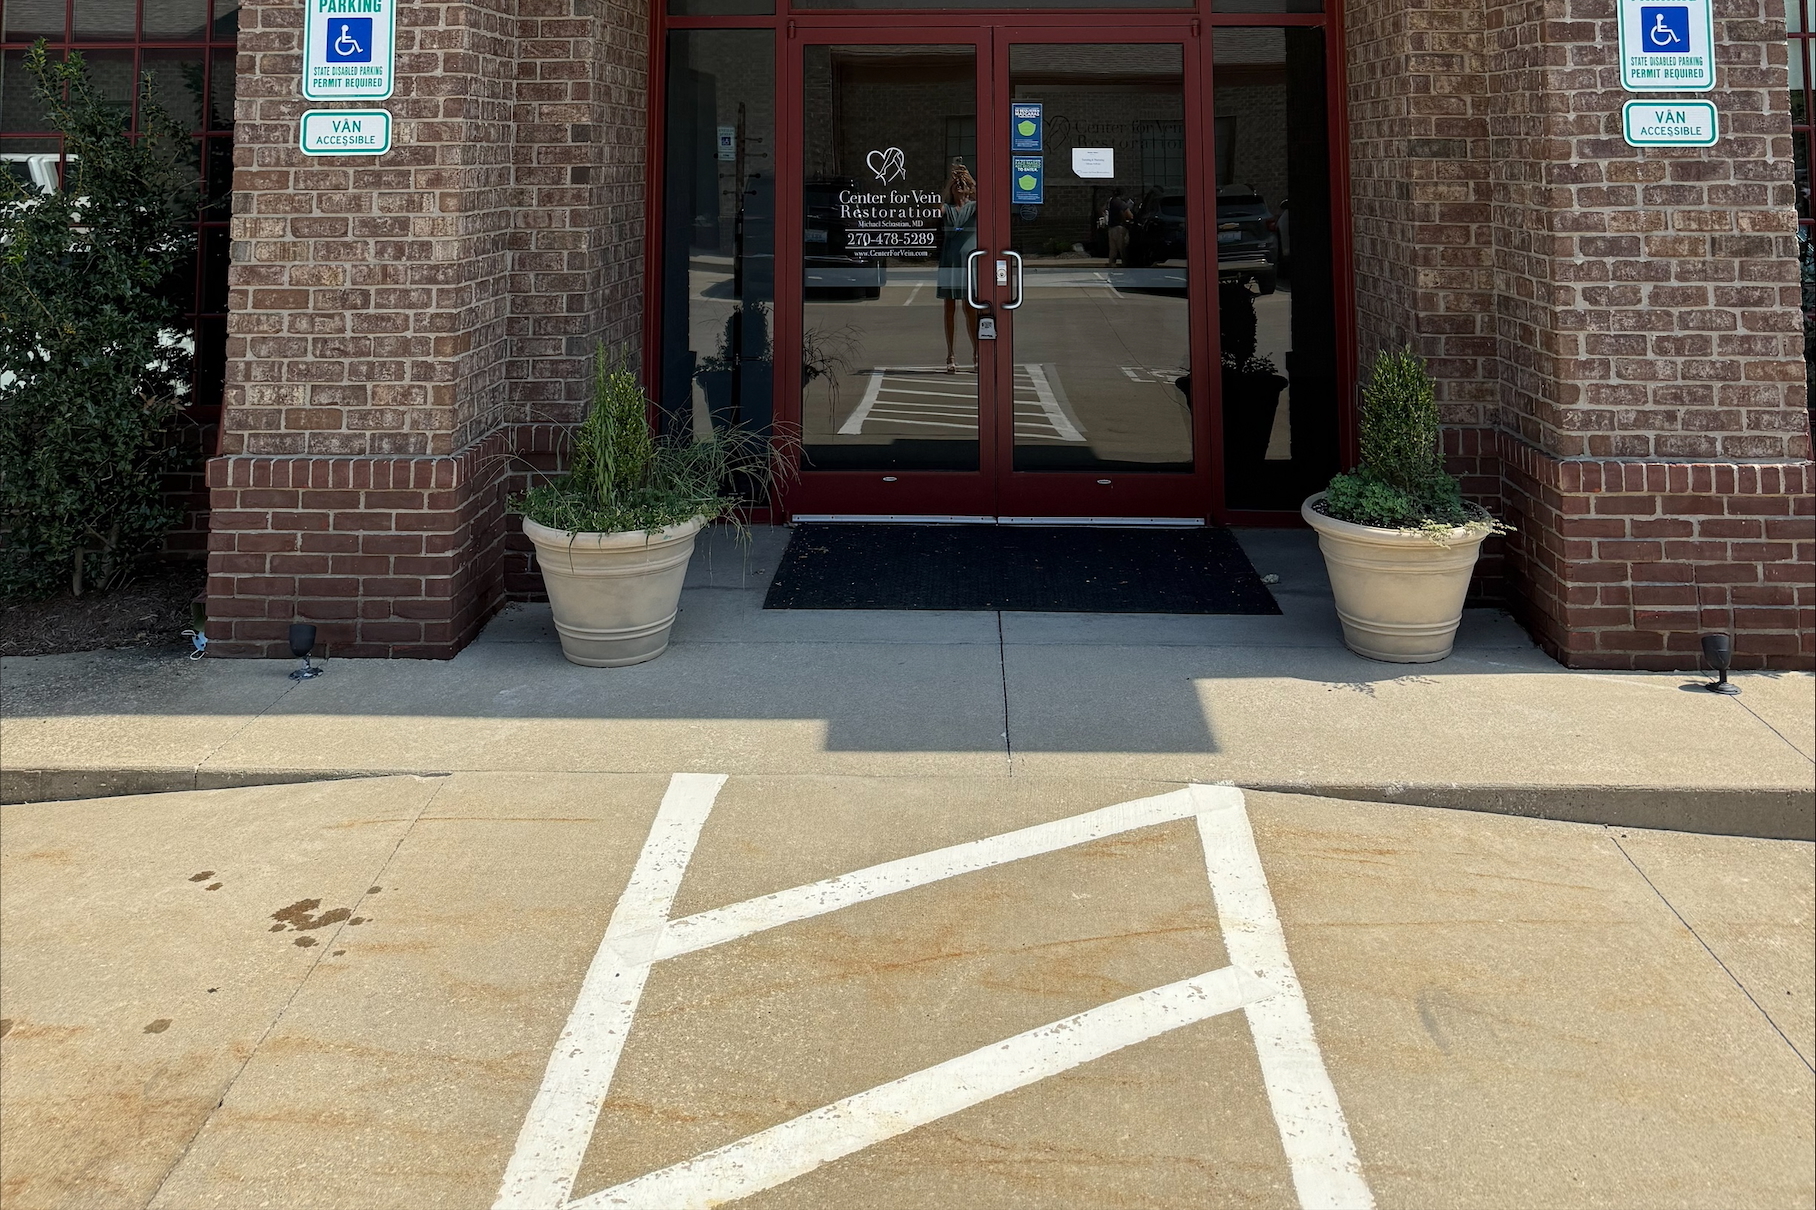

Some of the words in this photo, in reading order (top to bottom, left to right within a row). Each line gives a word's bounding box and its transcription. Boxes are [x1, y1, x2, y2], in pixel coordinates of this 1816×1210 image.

[1630, 56, 1648, 66] STATE
[1649, 56, 1676, 66] DISABLED
[1678, 56, 1703, 66] PARKING
[313, 66, 330, 76] STATE
[332, 66, 358, 76] DISABLED
[359, 66, 383, 75] PARKING
[1631, 69, 1660, 79] PERMIT
[1664, 69, 1704, 80] REQUIRED
[313, 78, 341, 88] PERMIT
[345, 78, 383, 89] REQUIRED
[1655, 111, 1686, 124] VAN
[332, 120, 362, 133] VAN
[1640, 126, 1702, 136] ACCESSIBLE
[315, 135, 376, 145] ACCESSIBLE
[839, 190, 887, 204] Center
[890, 190, 910, 204] for
[911, 190, 942, 204] Vein
[840, 204, 943, 218] Restoration
[858, 220, 881, 228] Michael
[881, 220, 911, 228] Sebastian,
[847, 232, 935, 245] 270-478-5289
[853, 249, 928, 257] www.CenterForVein.com
